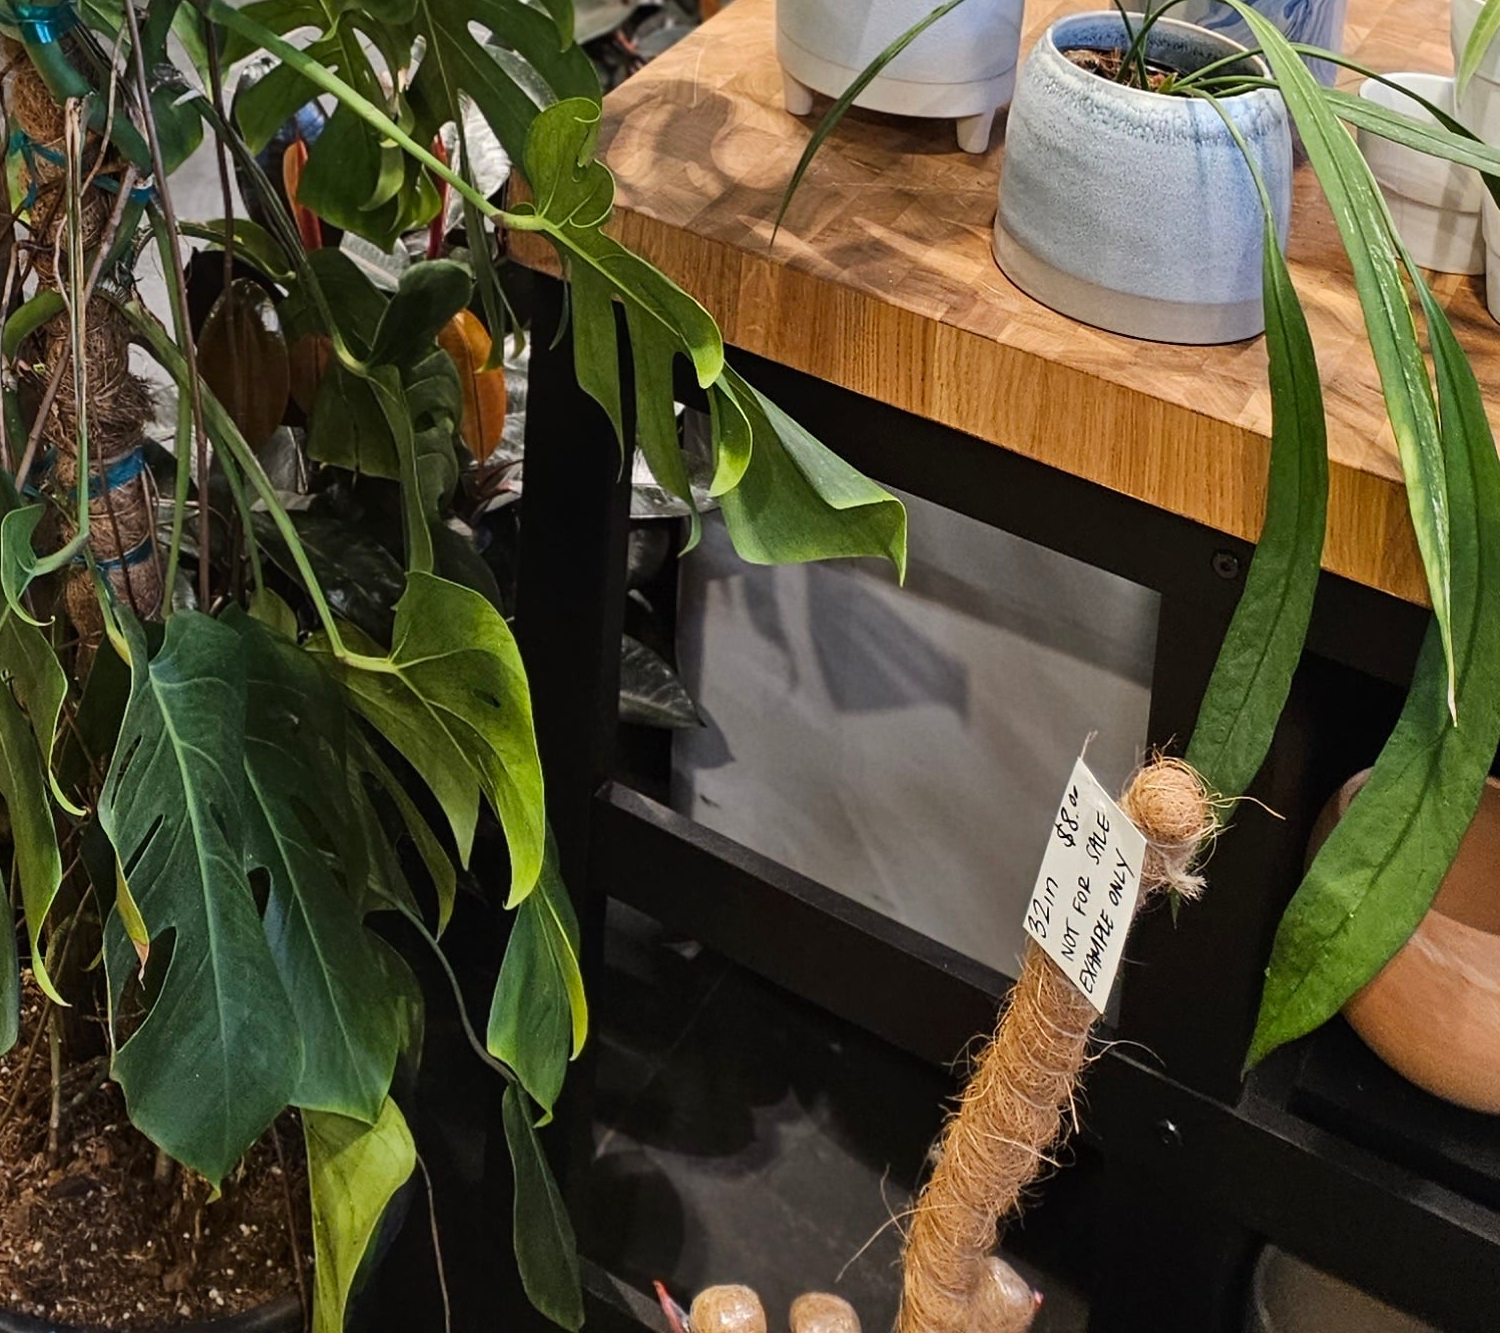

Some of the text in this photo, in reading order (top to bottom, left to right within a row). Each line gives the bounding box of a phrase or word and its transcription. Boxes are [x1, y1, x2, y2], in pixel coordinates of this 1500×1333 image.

[1061, 810, 1110, 962] NOT FOR SALE
[1079, 847, 1135, 994] EXAMPLE ONLY
